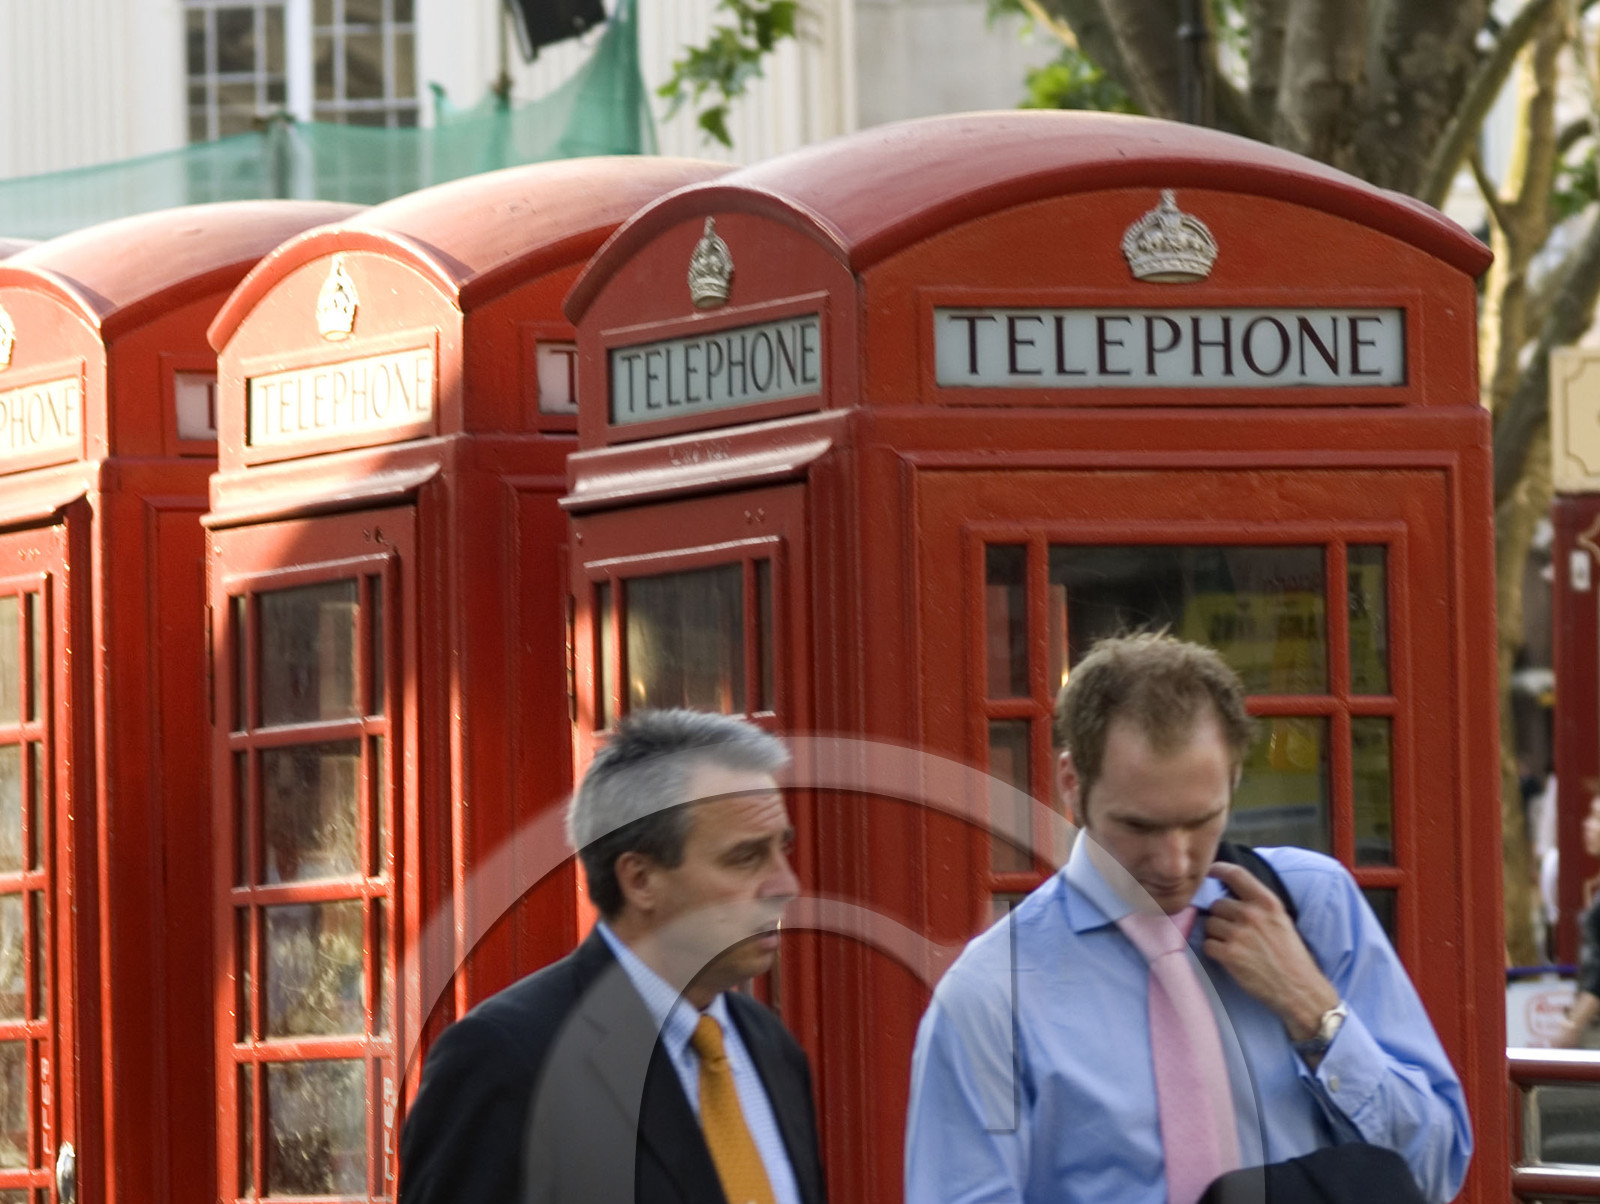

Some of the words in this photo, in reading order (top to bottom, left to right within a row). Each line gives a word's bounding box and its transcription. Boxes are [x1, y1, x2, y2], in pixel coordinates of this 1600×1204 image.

[619, 320, 818, 413] TELEPHONE
[949, 314, 1384, 377] TELEPHONE
[259, 355, 429, 436] TELEPHONE
